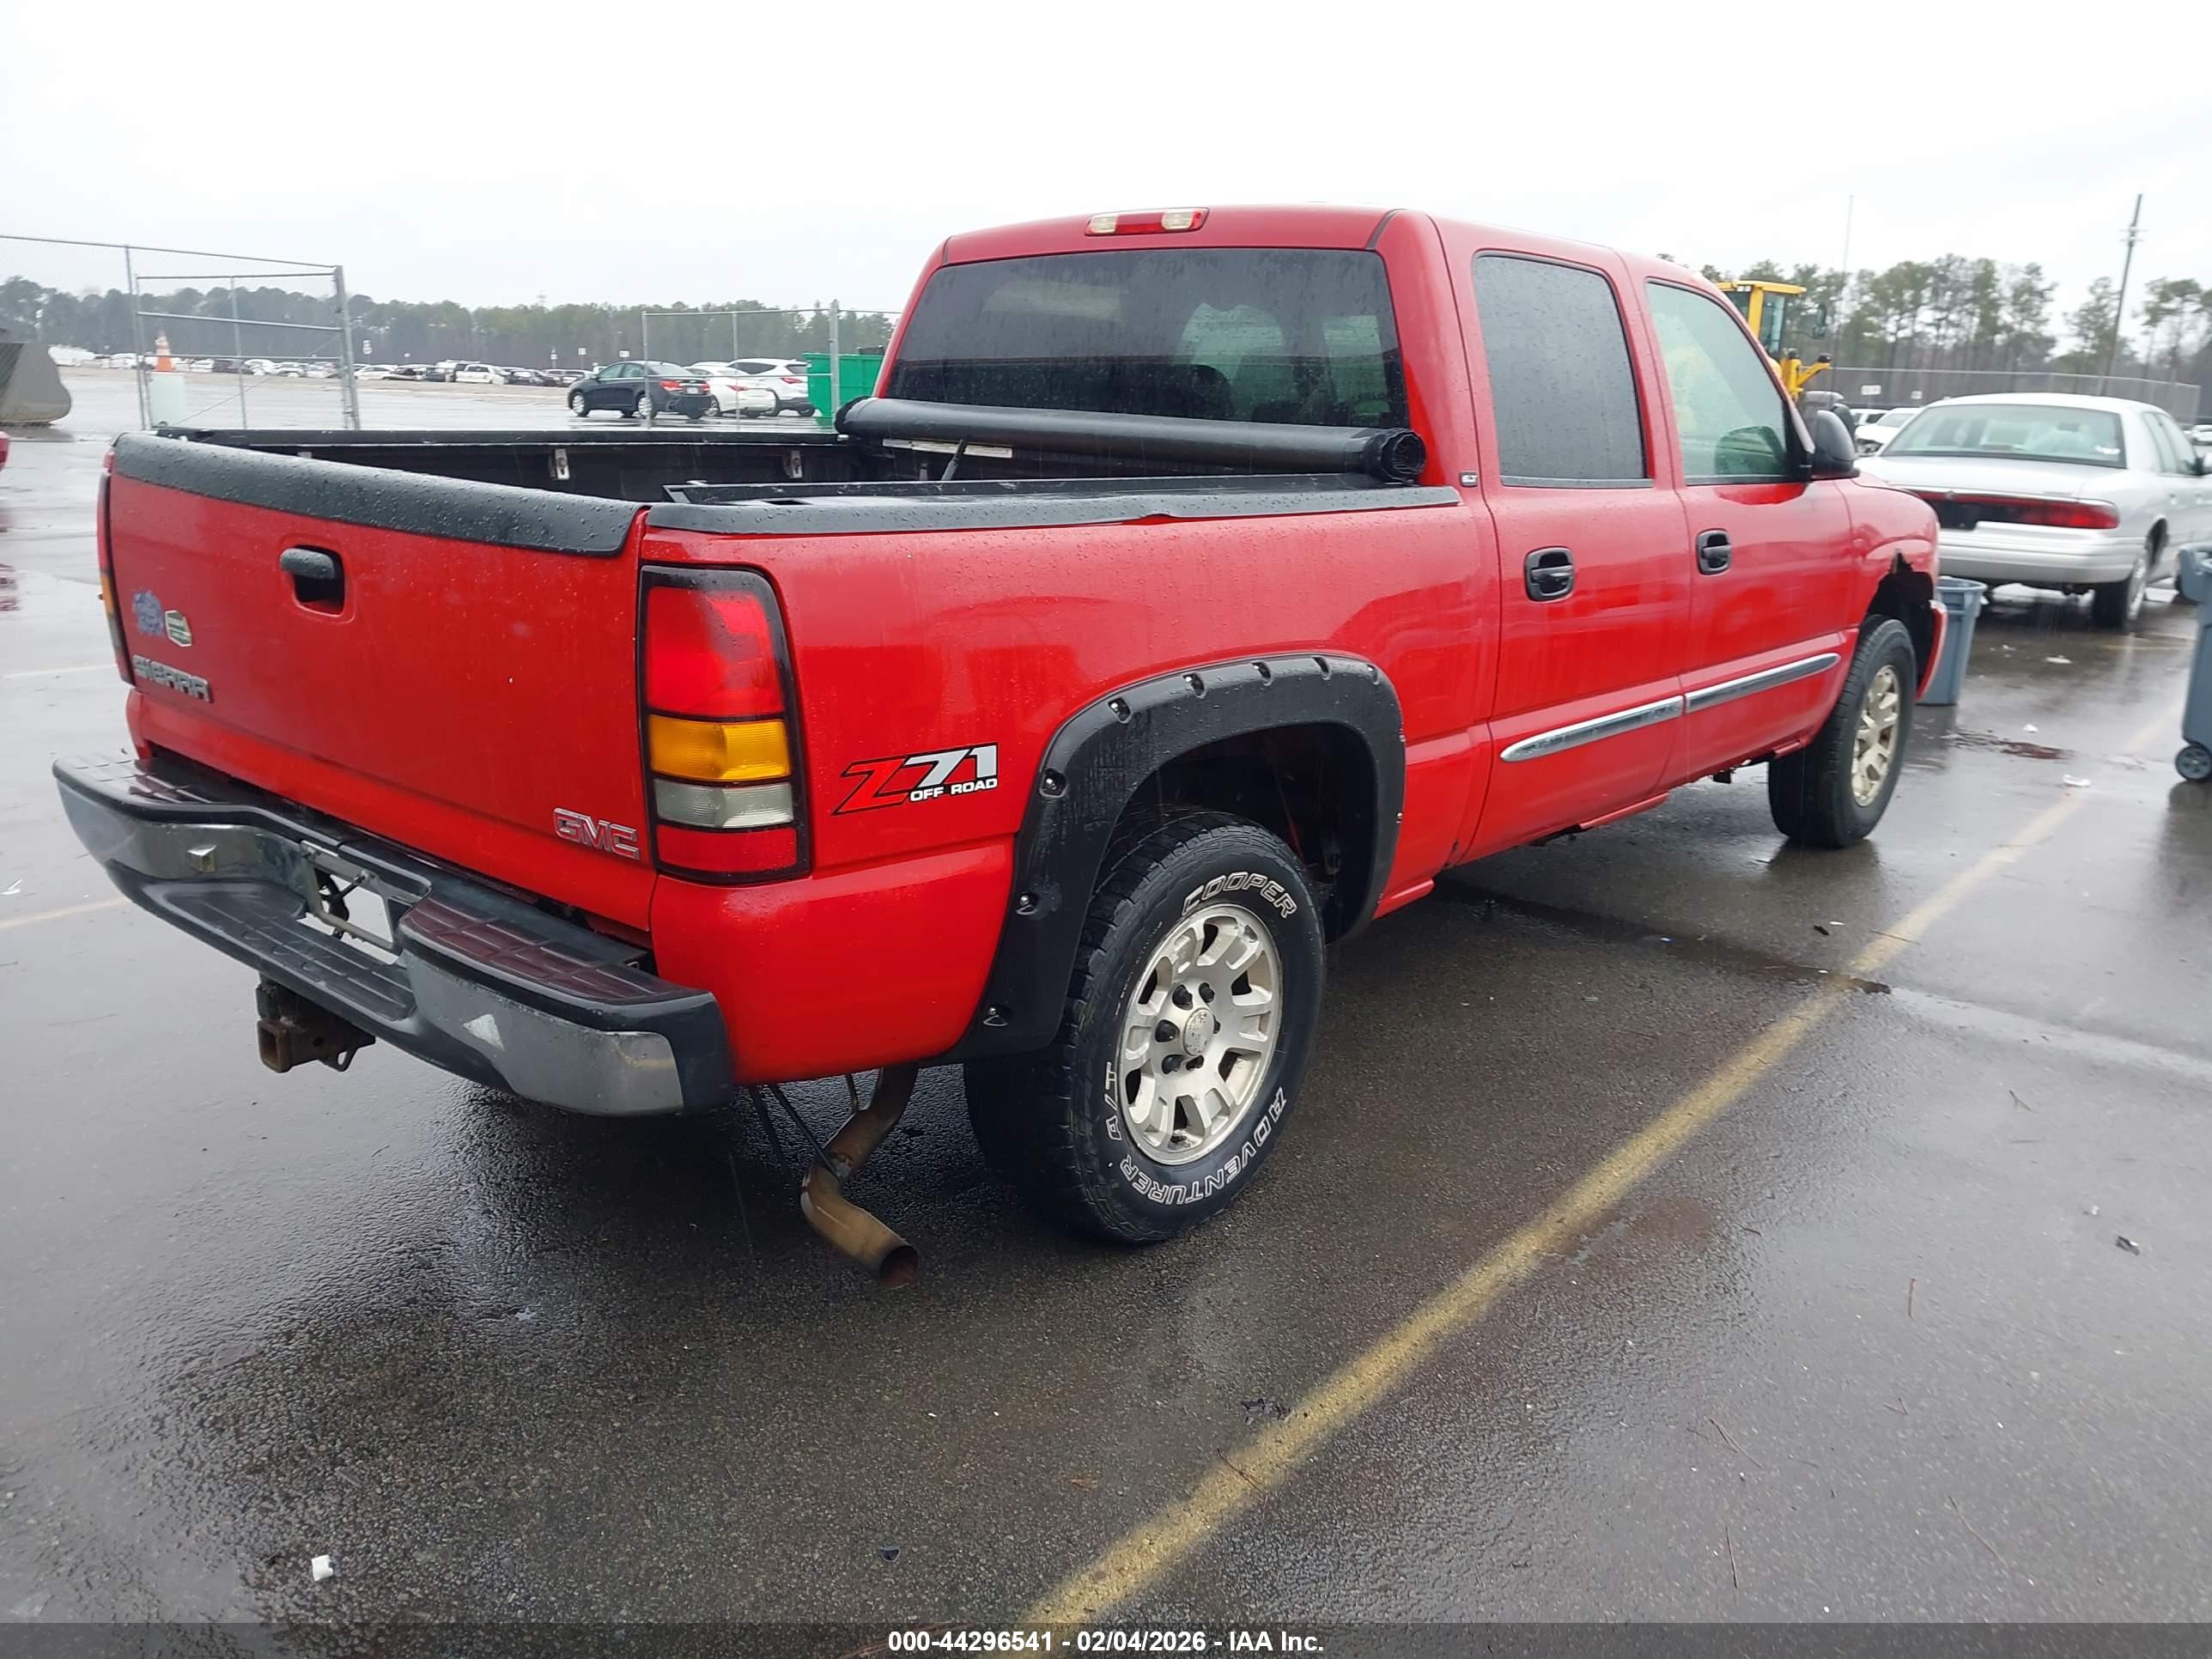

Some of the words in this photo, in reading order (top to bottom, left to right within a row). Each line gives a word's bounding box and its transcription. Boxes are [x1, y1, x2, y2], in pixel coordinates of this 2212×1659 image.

[132, 654, 210, 702] SIERRA
[832, 741, 999, 816] Z71
[909, 787, 945, 802] OFF
[950, 777, 999, 795] ROAD
[552, 807, 640, 860] GMC
[1181, 871, 1297, 919] COOPER
[1119, 1086, 1288, 1206] ADVENTURER
